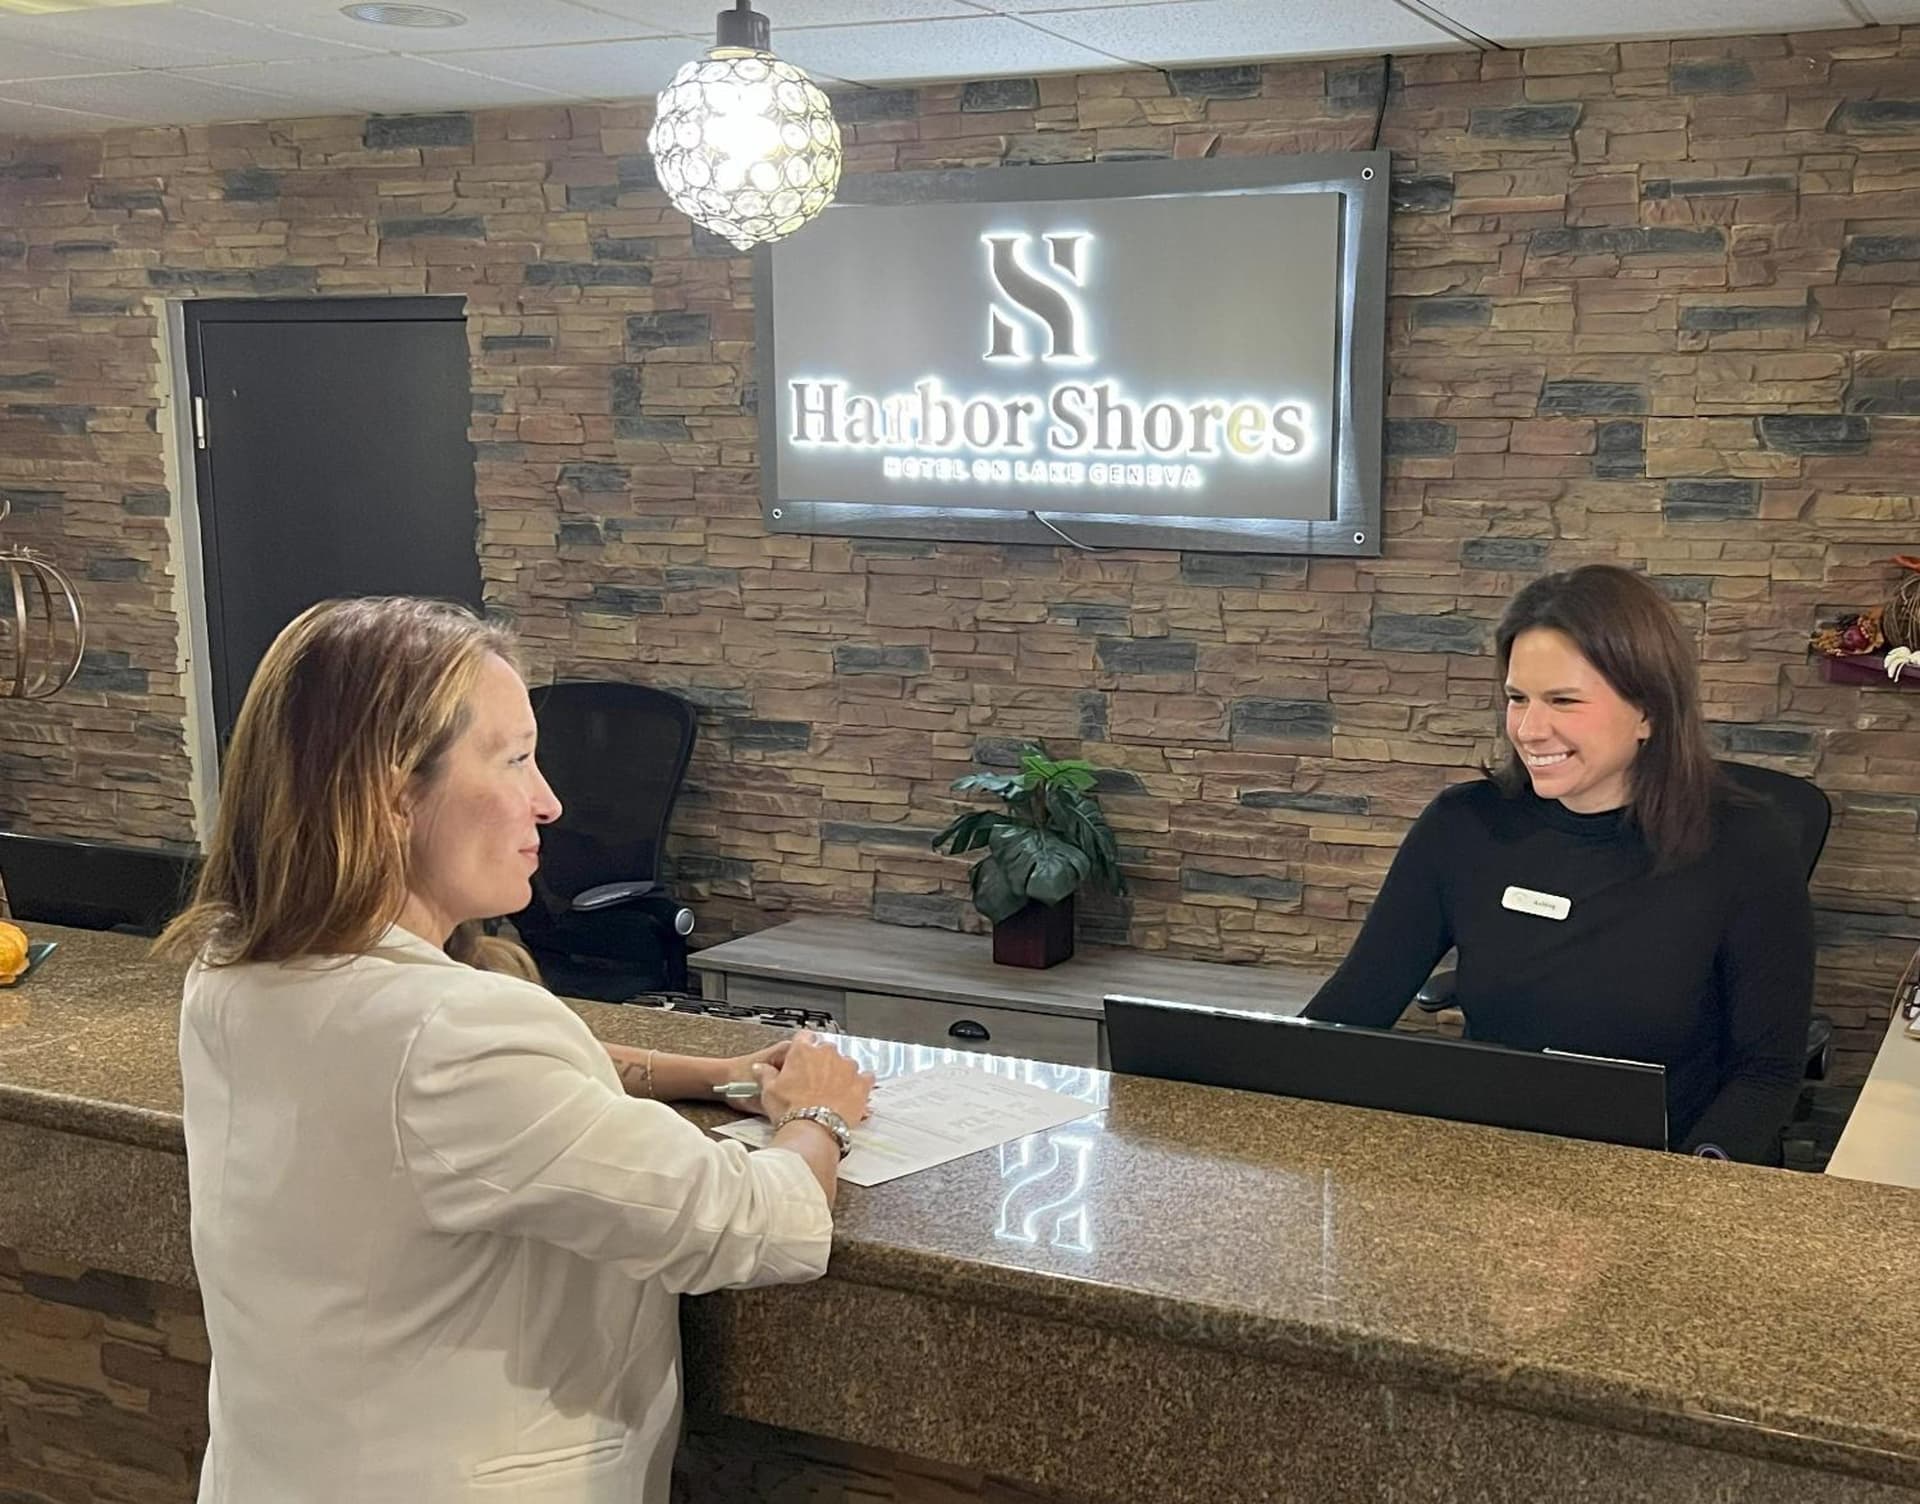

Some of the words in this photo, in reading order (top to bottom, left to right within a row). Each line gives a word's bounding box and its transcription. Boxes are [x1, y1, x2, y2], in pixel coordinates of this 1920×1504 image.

[790, 380, 1035, 448] Harbor
[1050, 383, 1306, 456] Shores
[885, 458, 967, 479] HOTEL
[973, 459, 1012, 480] ON
[1015, 461, 1083, 483] LAKE
[1090, 464, 1202, 486] GENEVA
